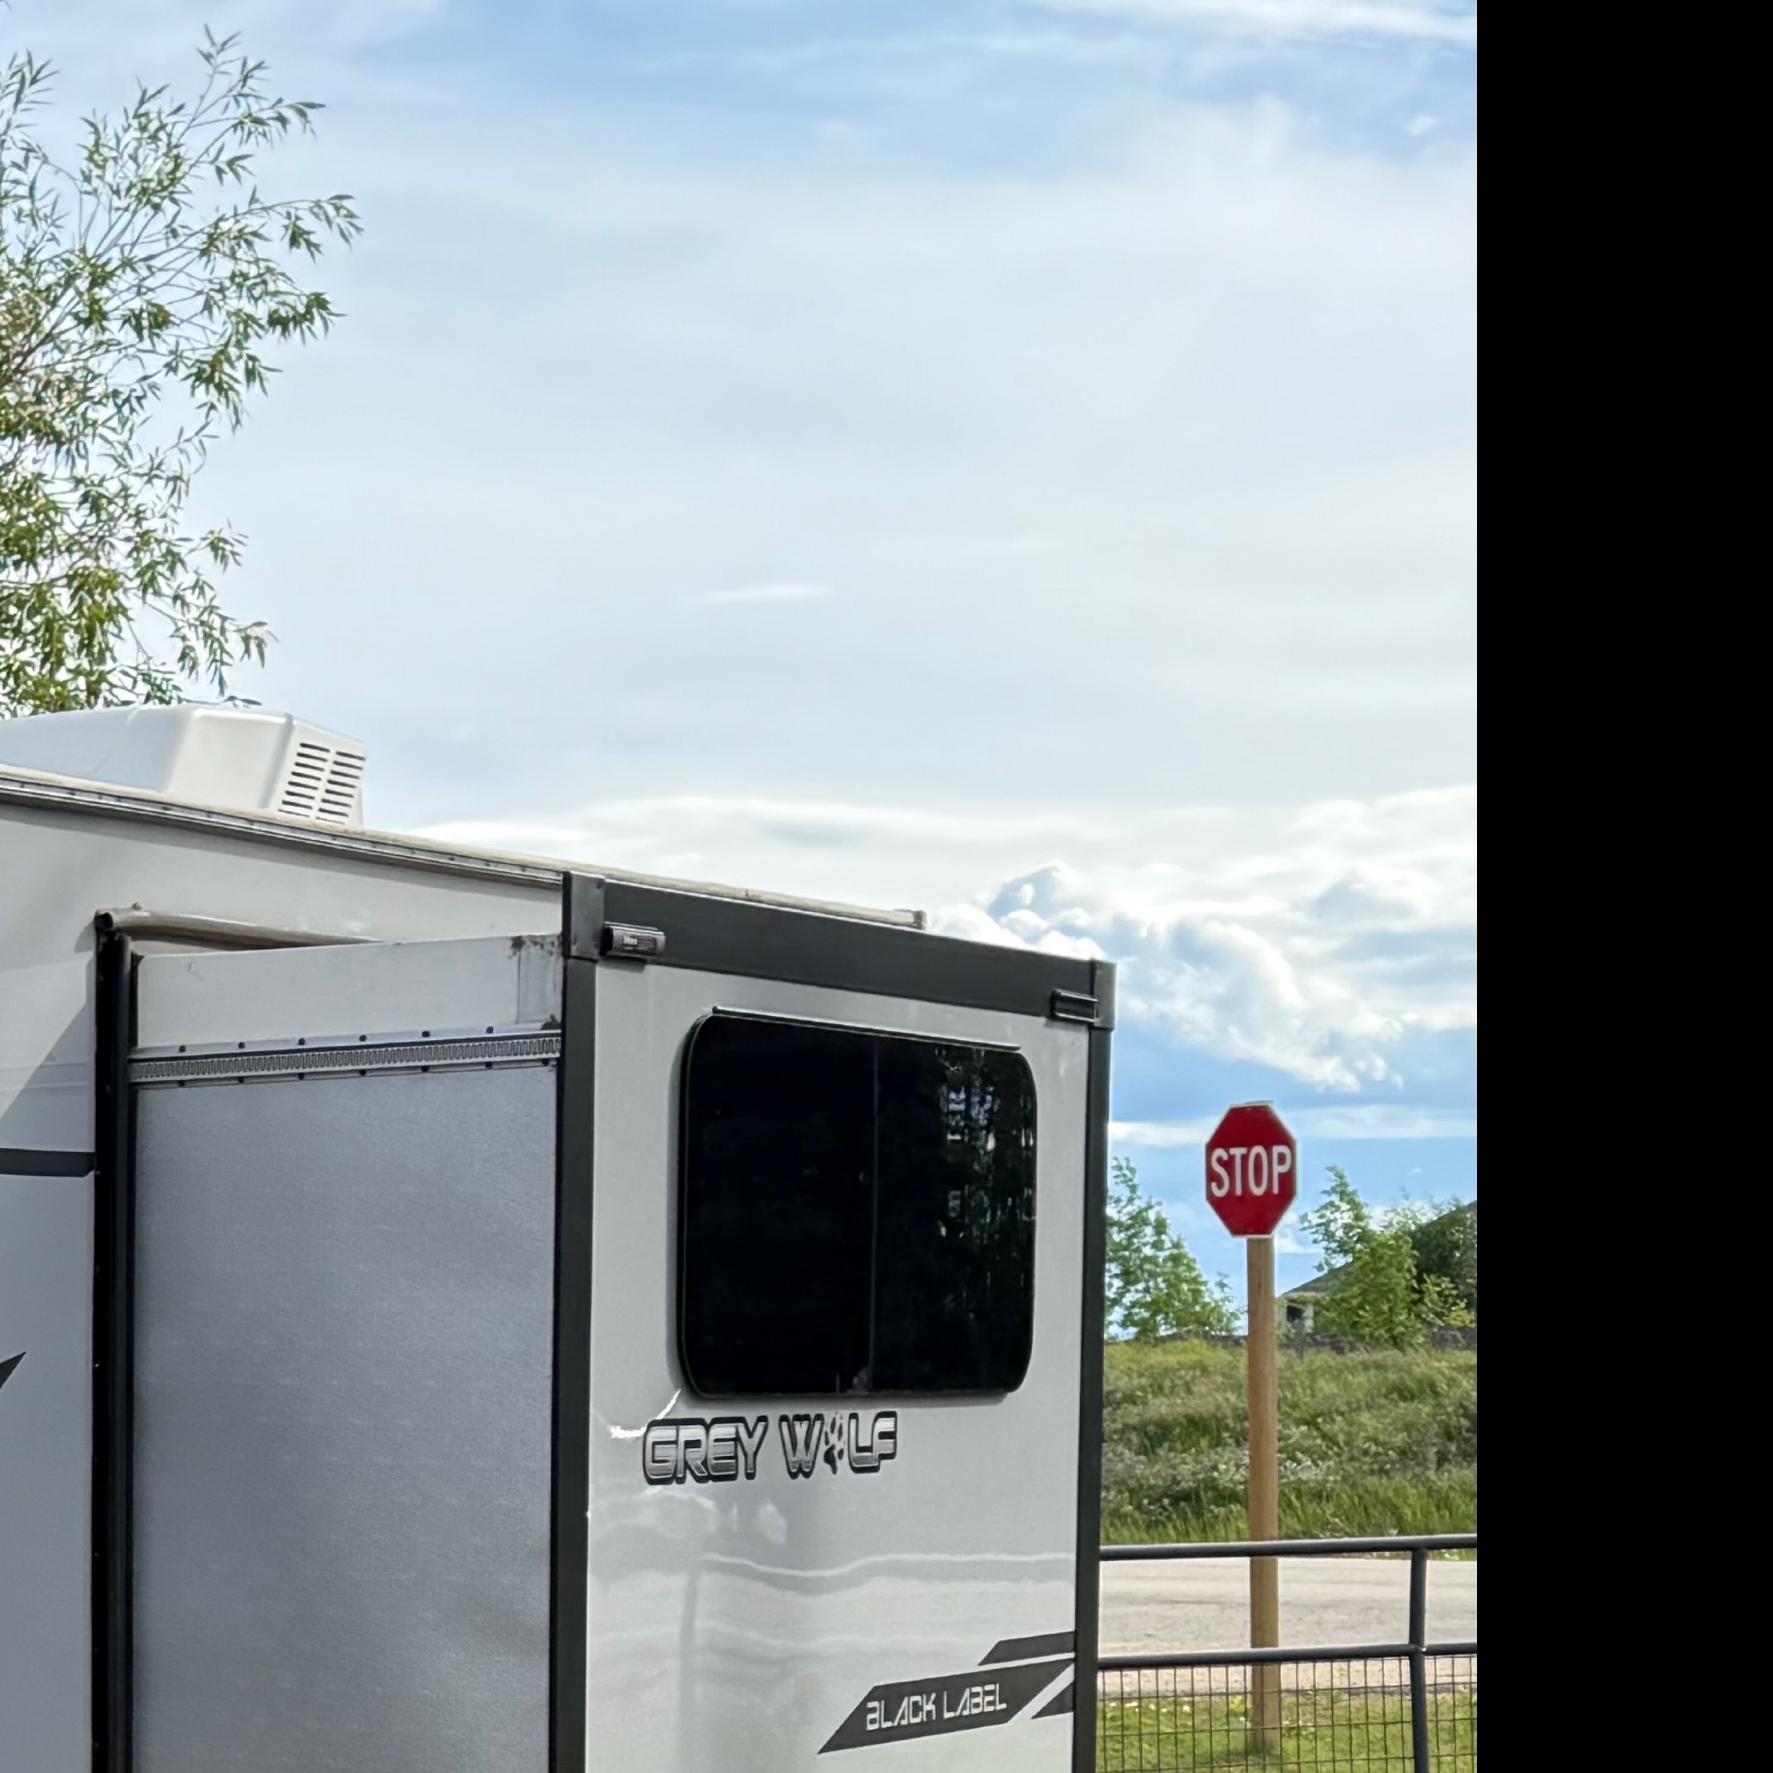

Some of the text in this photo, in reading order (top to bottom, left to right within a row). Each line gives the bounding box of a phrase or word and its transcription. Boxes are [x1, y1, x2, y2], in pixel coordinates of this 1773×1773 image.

[1210, 1144, 1292, 1198] STOP
[642, 1410, 898, 1486] GREY WLF
[866, 1682, 1008, 1731] BLACK LABEL
